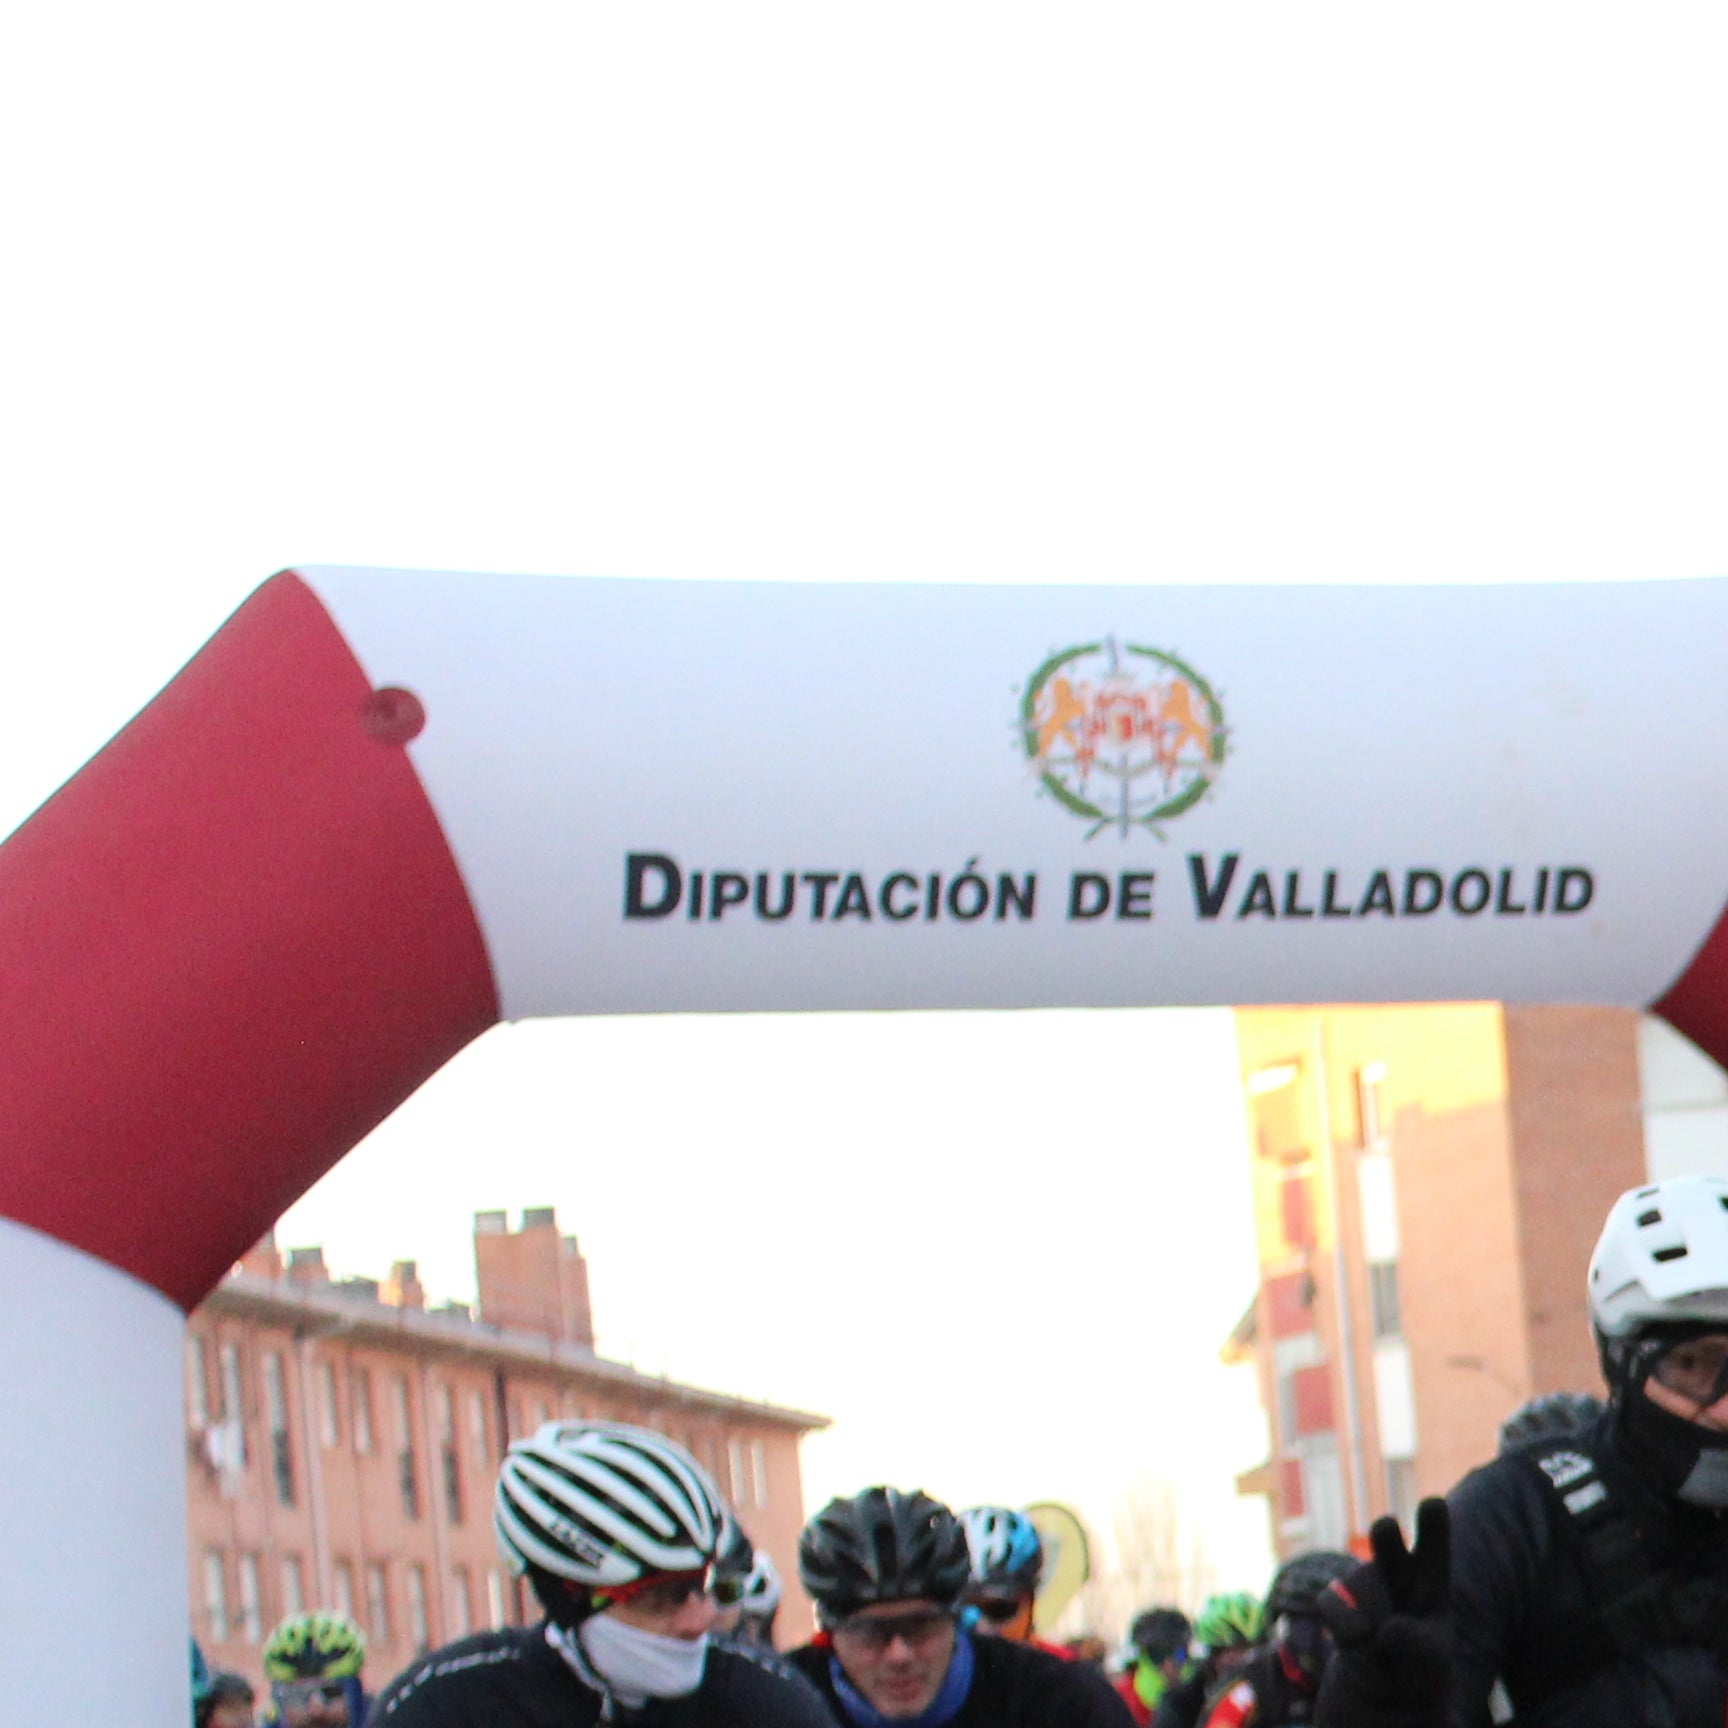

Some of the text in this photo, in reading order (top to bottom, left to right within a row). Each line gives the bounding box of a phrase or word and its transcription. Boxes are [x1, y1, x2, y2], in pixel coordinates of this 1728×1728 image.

[619, 850, 1597, 922] DIPUTACIÓN DE VALLADOLID
